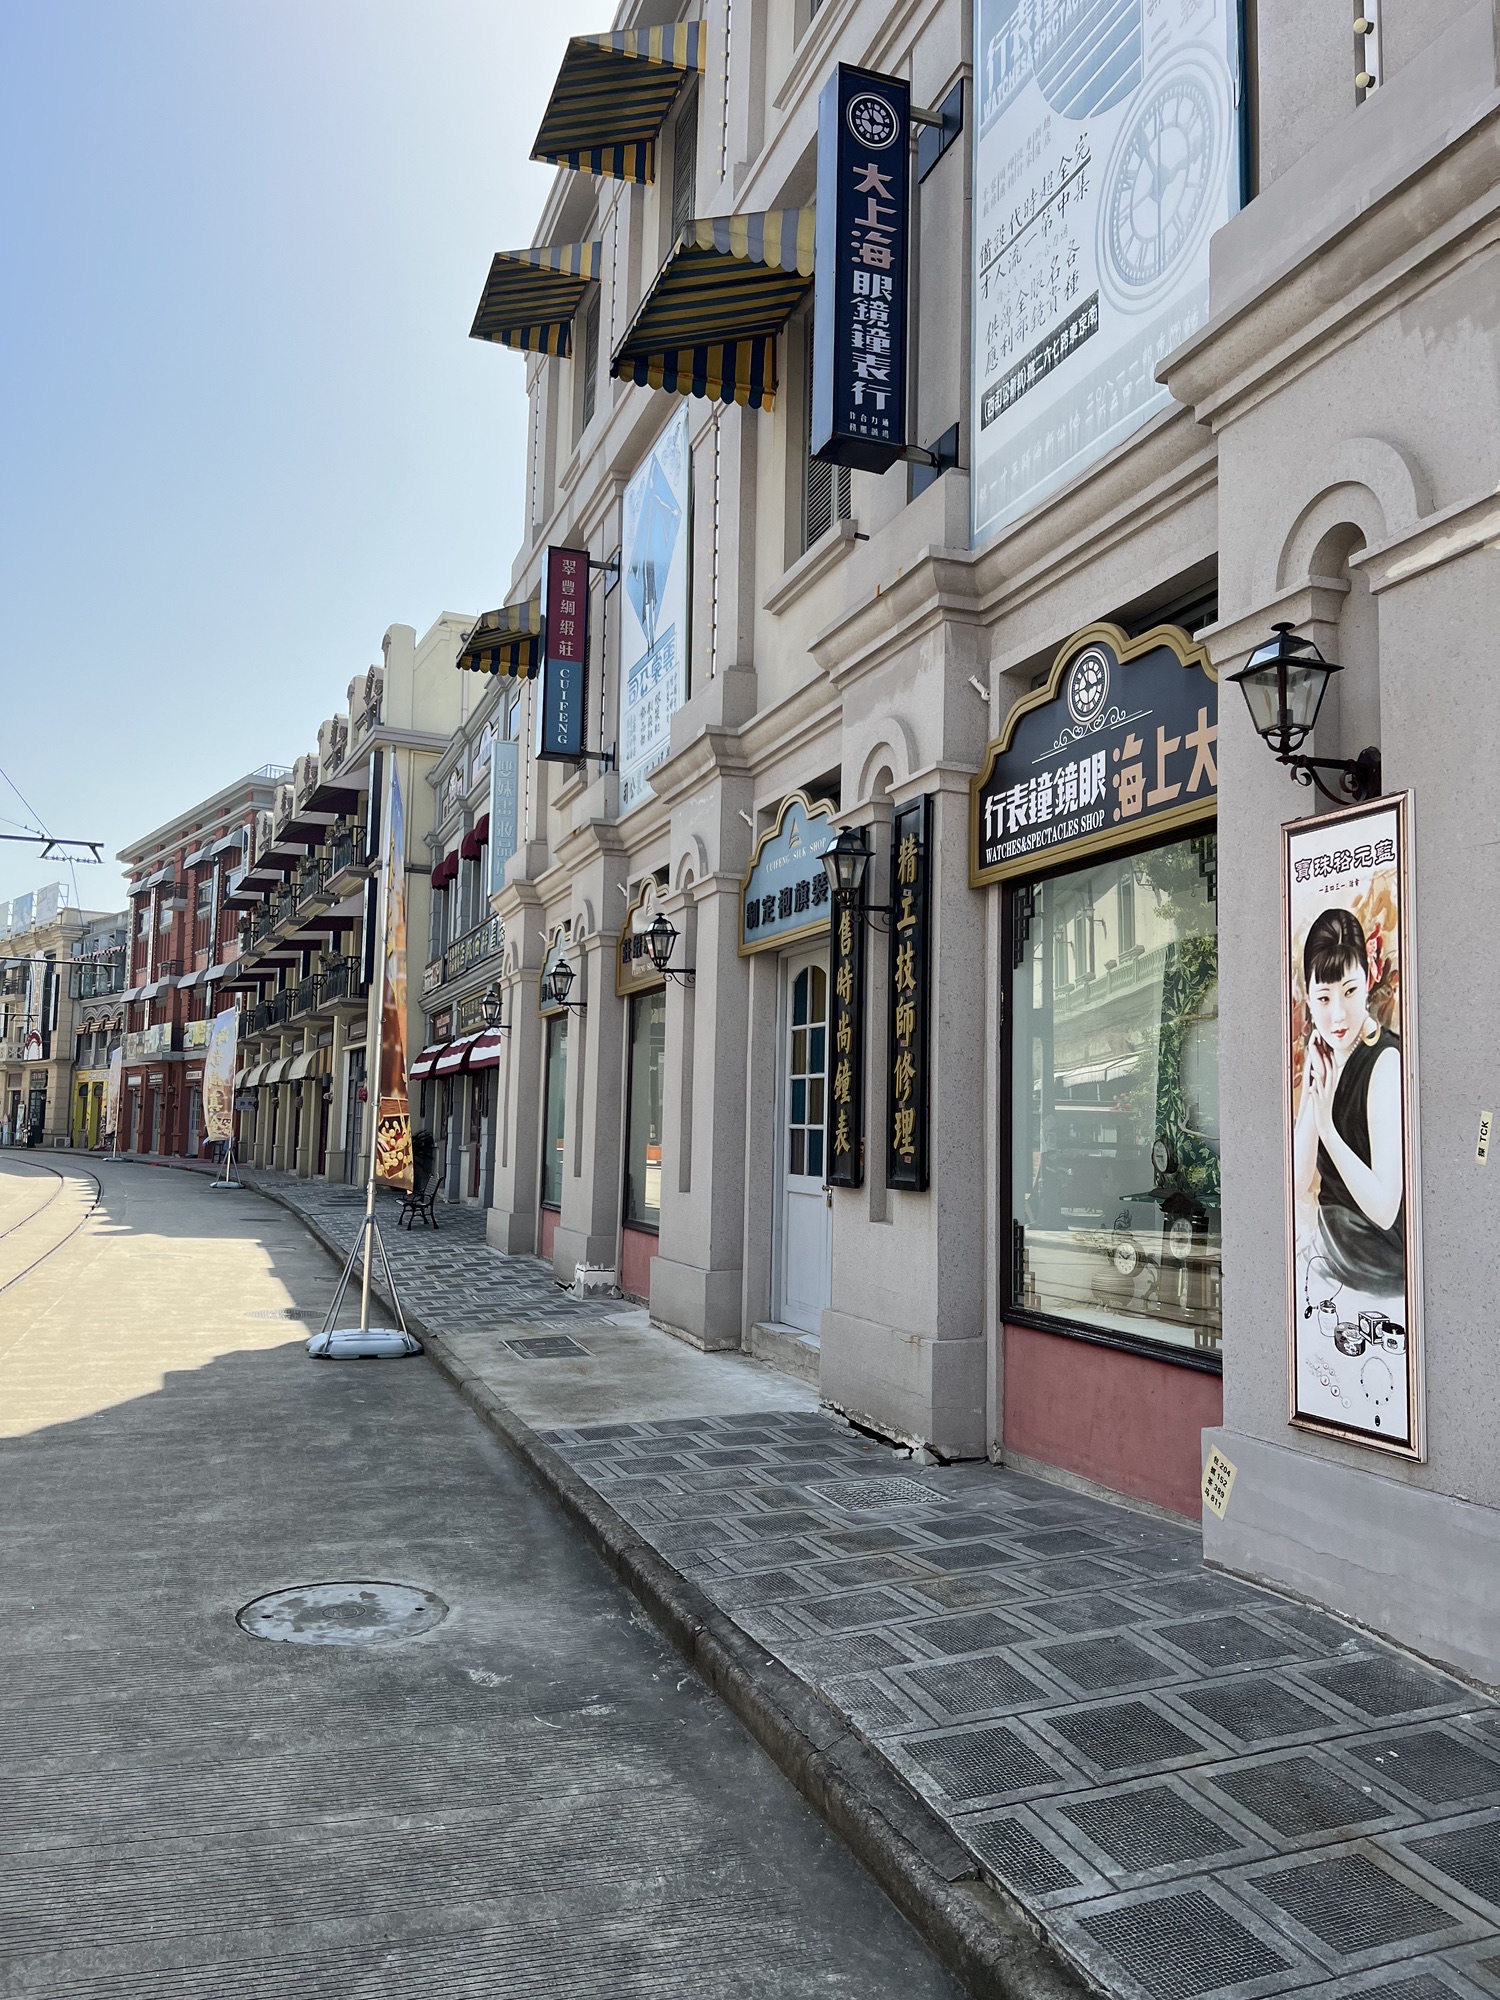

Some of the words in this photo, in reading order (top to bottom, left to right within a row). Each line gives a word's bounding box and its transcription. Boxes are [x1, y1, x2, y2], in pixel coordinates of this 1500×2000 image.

[557, 668, 570, 744] CUIFENG
[985, 821, 1079, 864] WATCHES&SPECTACLES
[1081, 809, 1105, 833] SHOP
[766, 854, 790, 873] CUIFENG
[793, 848, 807, 861] SILK
[809, 838, 827, 853] SHOP
[894, 833, 919, 1156] 精工技師修理
[1480, 1120, 1489, 1142] TCK
[1217, 1473, 1228, 1488] 152
[1219, 1462, 1231, 1477] 204
[1210, 1495, 1222, 1509] 811
[1214, 1484, 1225, 1498] 389
